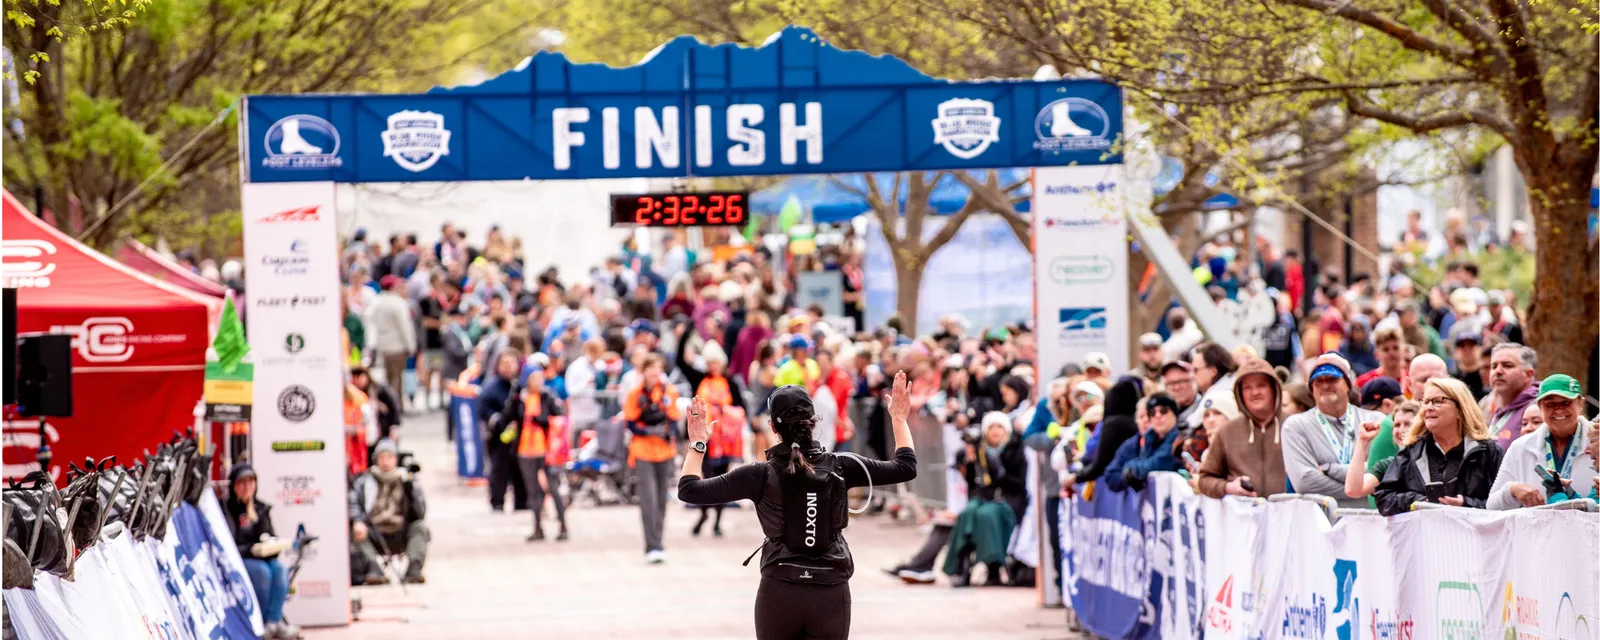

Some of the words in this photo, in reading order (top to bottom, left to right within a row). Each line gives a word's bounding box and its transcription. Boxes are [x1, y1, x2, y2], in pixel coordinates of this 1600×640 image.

[552, 102, 823, 170] FINISH
[805, 492, 818, 547] INOXTO
[1283, 595, 1313, 638] Anthem
